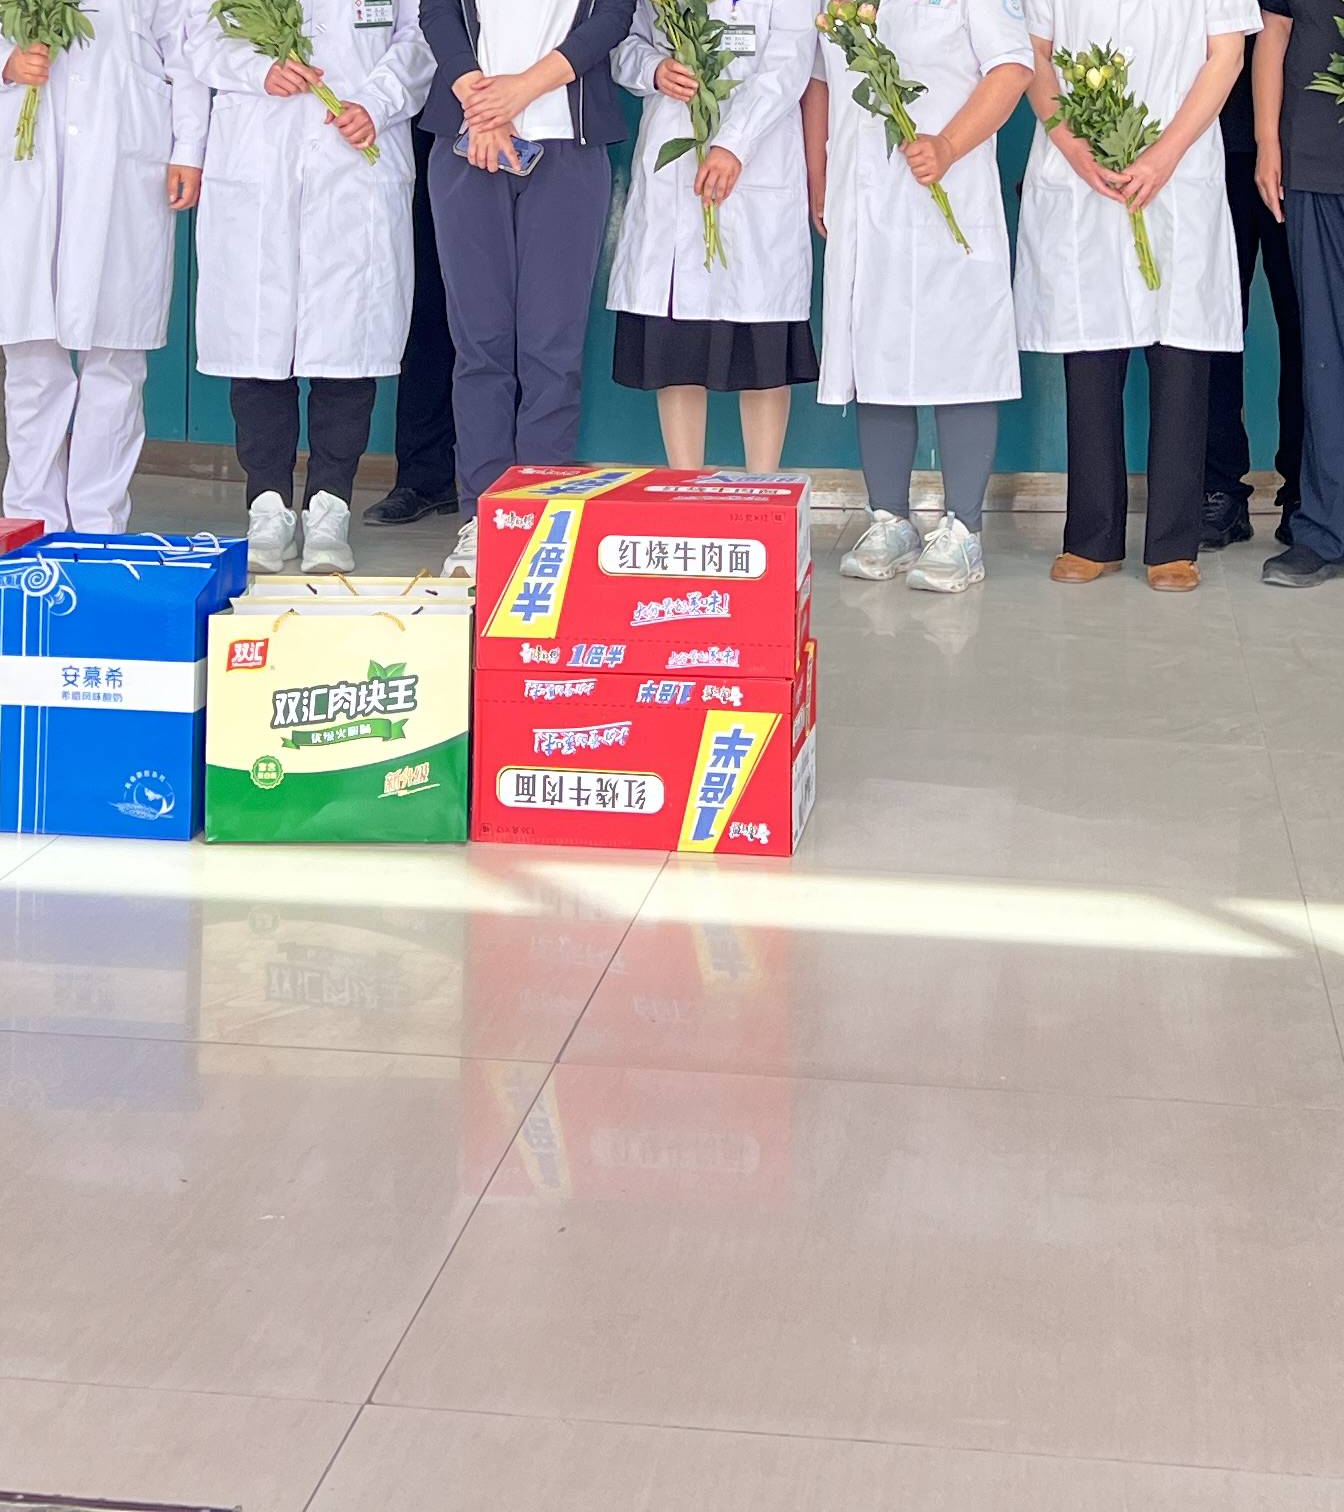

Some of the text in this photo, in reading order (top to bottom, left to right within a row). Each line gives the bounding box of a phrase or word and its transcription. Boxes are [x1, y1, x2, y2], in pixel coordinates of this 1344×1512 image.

[510, 509, 573, 622] 1倍半
[617, 539, 752, 574] 红烧牛肉面
[232, 641, 265, 663] 双汇
[566, 644, 627, 668] 1倍半
[61, 665, 123, 689] 安慕希
[273, 677, 417, 727] 双汇肉块王
[513, 772, 647, 811] 红烧牛肉面
[692, 727, 755, 842] 1倍半
